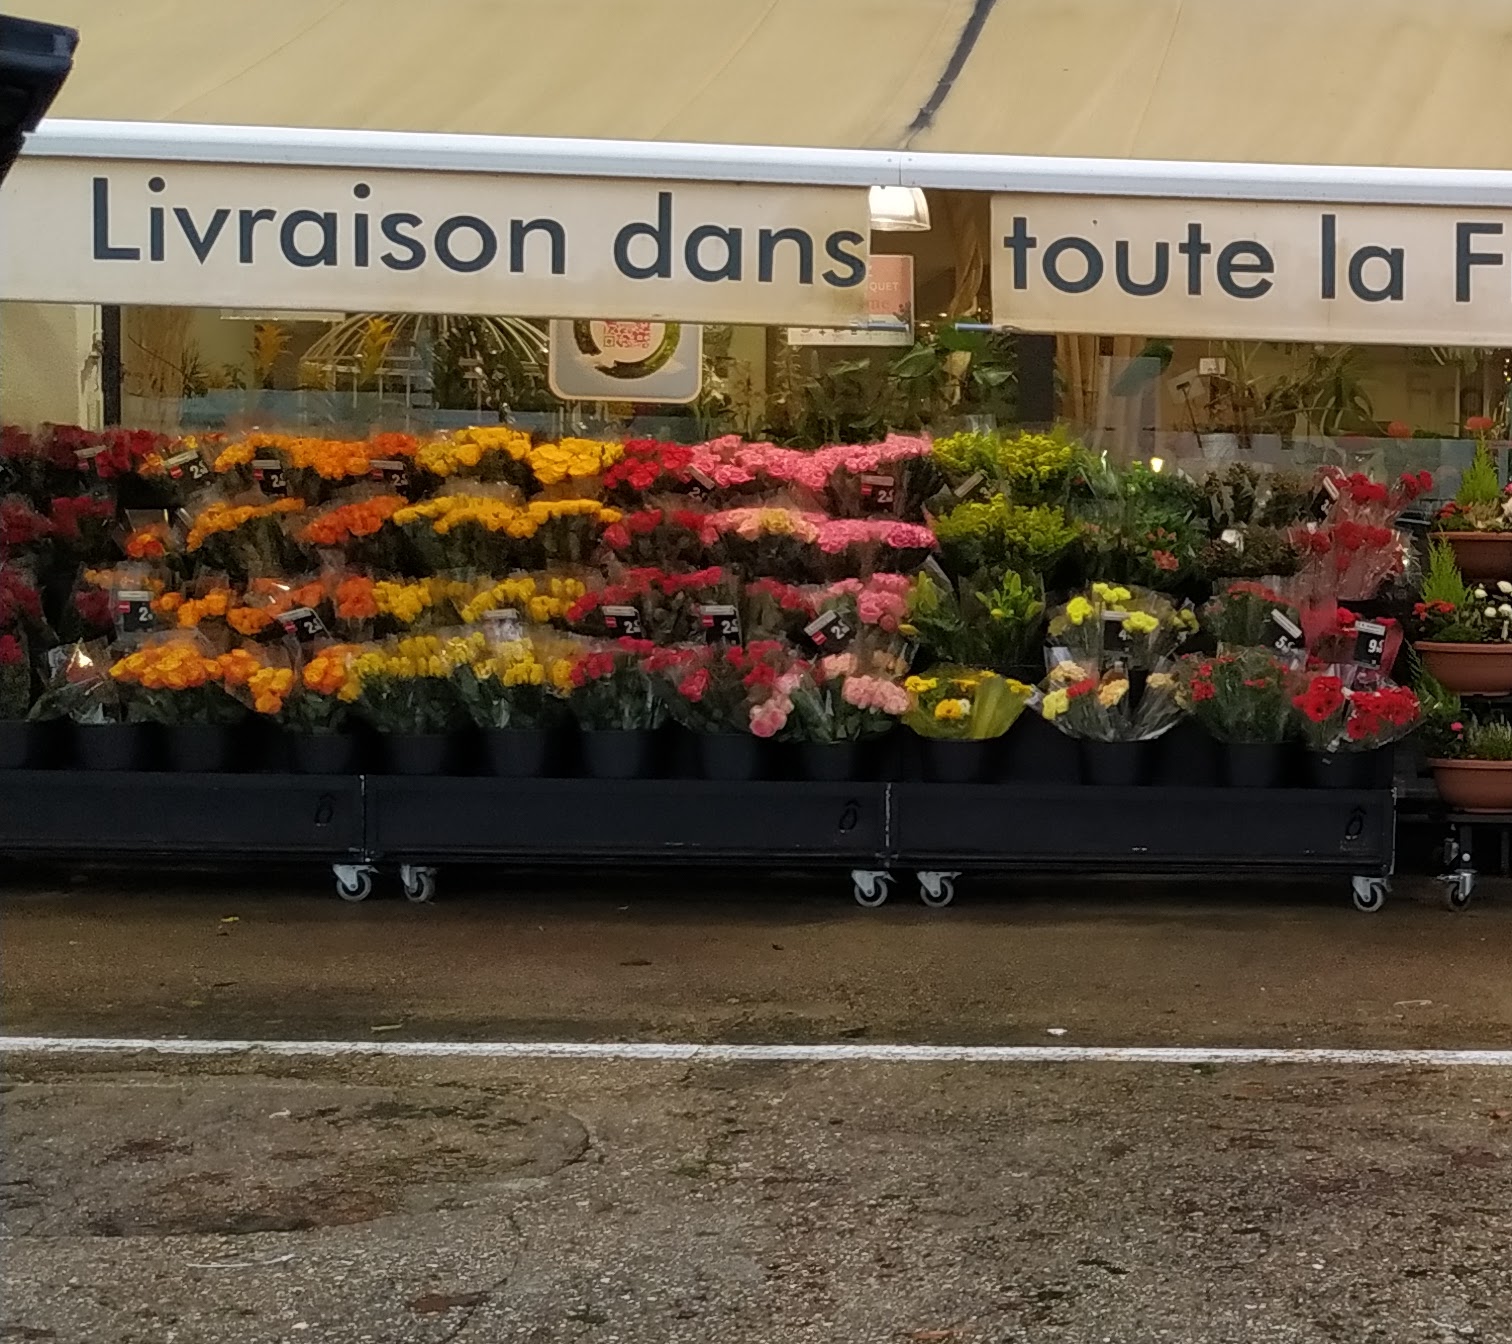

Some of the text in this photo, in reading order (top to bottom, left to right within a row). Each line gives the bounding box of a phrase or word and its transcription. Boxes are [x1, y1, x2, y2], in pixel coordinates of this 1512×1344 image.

[92, 175, 868, 289] Livraison dans
[1003, 215, 1276, 302] toute
[1321, 213, 1405, 304] la
